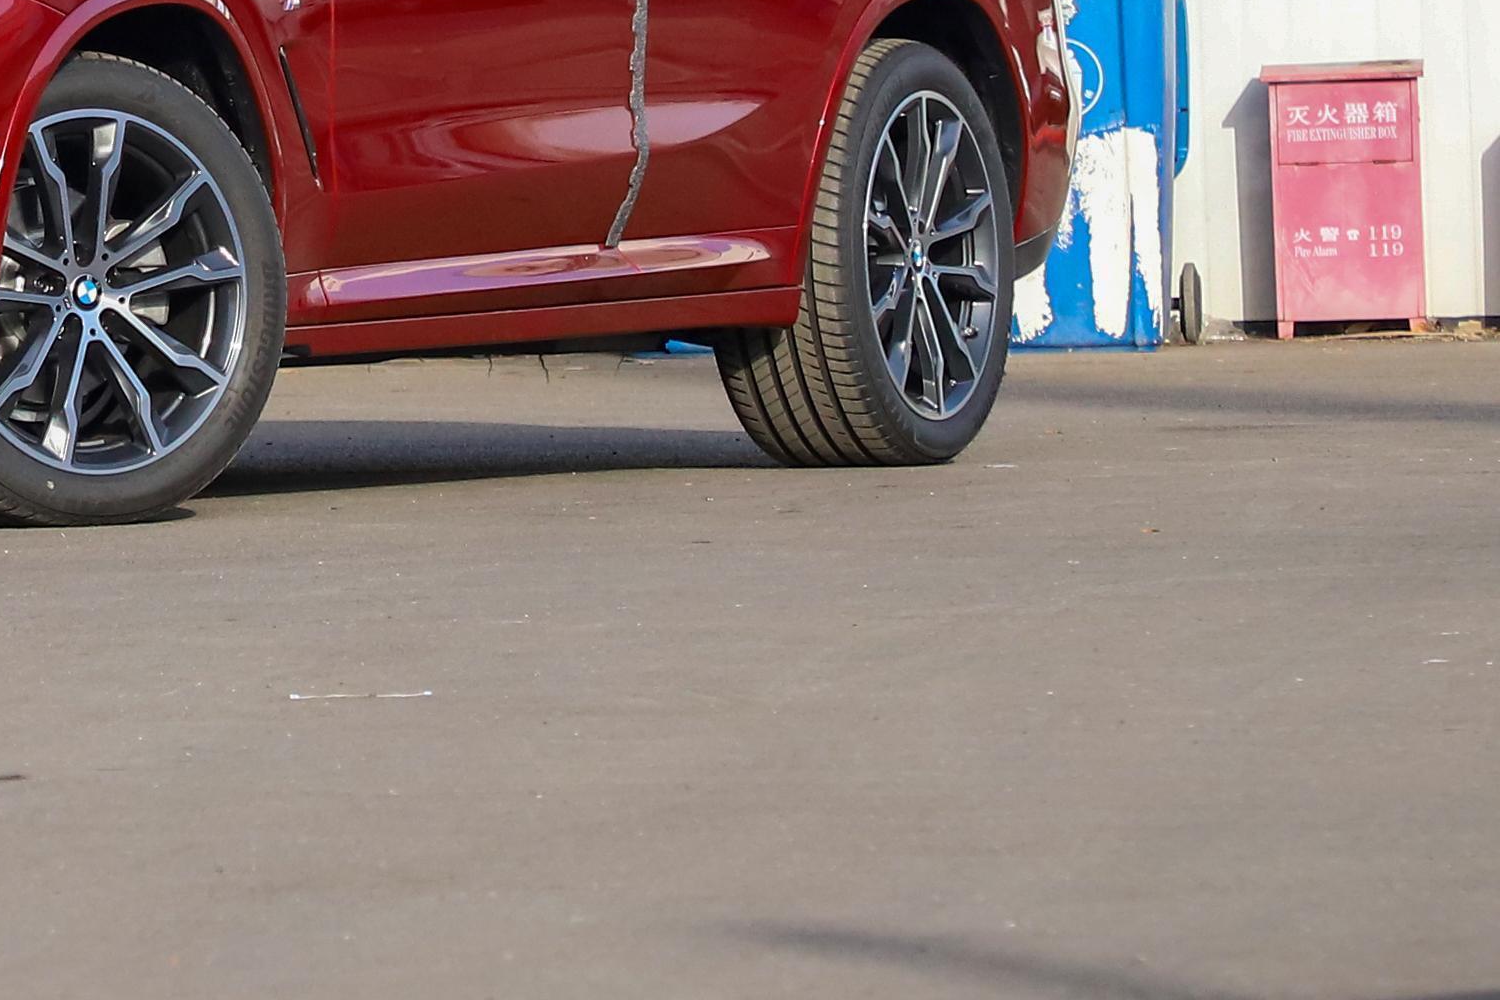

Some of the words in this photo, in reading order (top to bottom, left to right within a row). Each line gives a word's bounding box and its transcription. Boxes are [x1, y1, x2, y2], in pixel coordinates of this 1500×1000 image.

[1286, 101, 1397, 126] 灭火器箱
[1287, 128, 1308, 143] FIRE
[1309, 126, 1376, 142] EXTINGUISHER
[1378, 125, 1397, 140] BOX
[1370, 224, 1402, 241] 119
[1313, 245, 1338, 257] Alarm
[1370, 241, 1404, 257] 119
